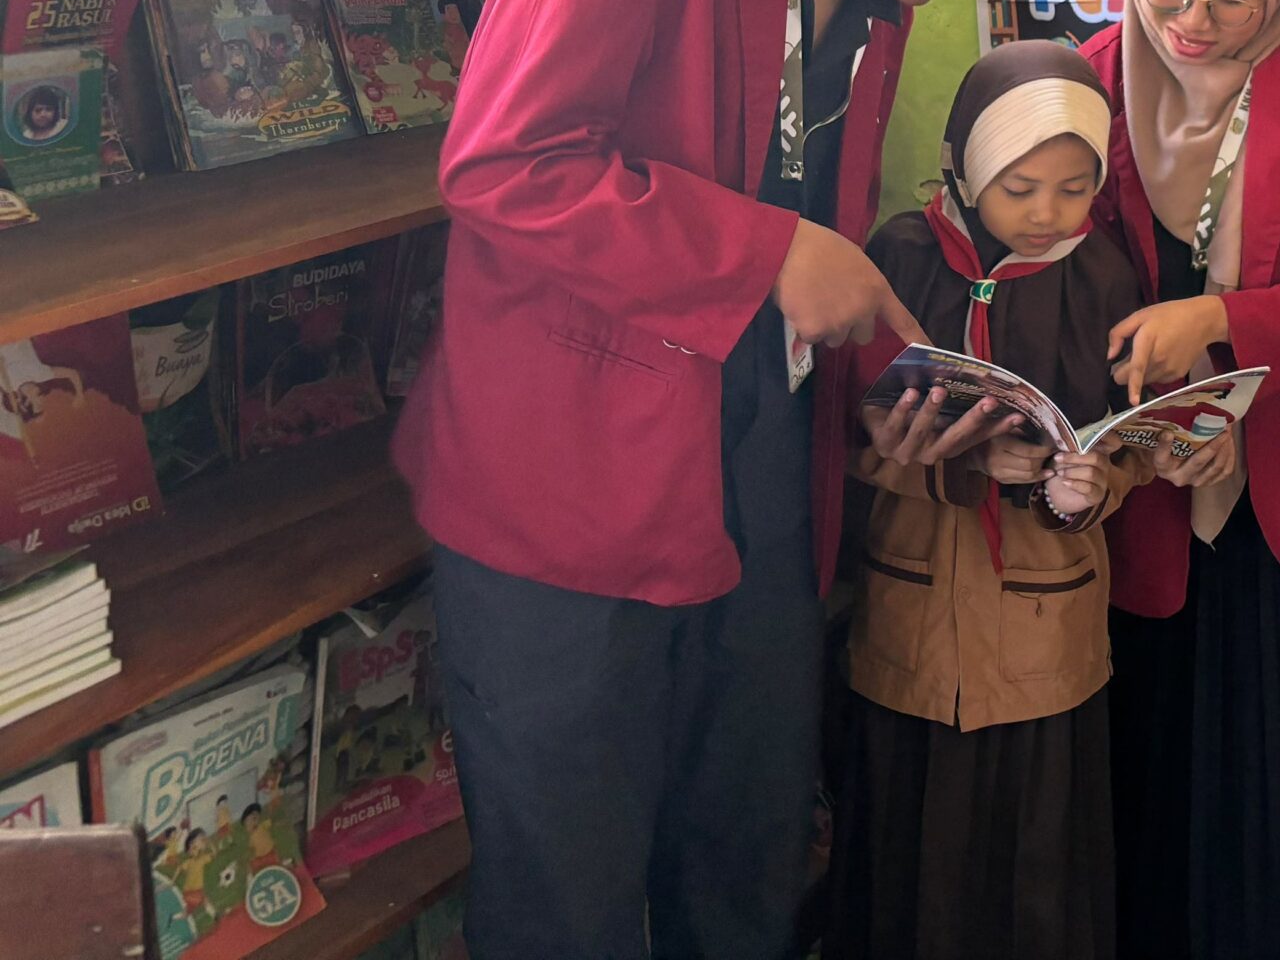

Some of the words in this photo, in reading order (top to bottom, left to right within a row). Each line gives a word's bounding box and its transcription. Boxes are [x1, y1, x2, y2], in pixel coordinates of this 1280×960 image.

[26, 0, 59, 29] 25
[57, 9, 113, 28] RASUL
[271, 104, 341, 123] WILD
[293, 259, 366, 288] BUDIDAYA
[268, 286, 349, 323] Stroberi
[142, 720, 270, 837] BUPENA
[332, 795, 401, 833] Pancasila
[252, 879, 298, 918] 5A
